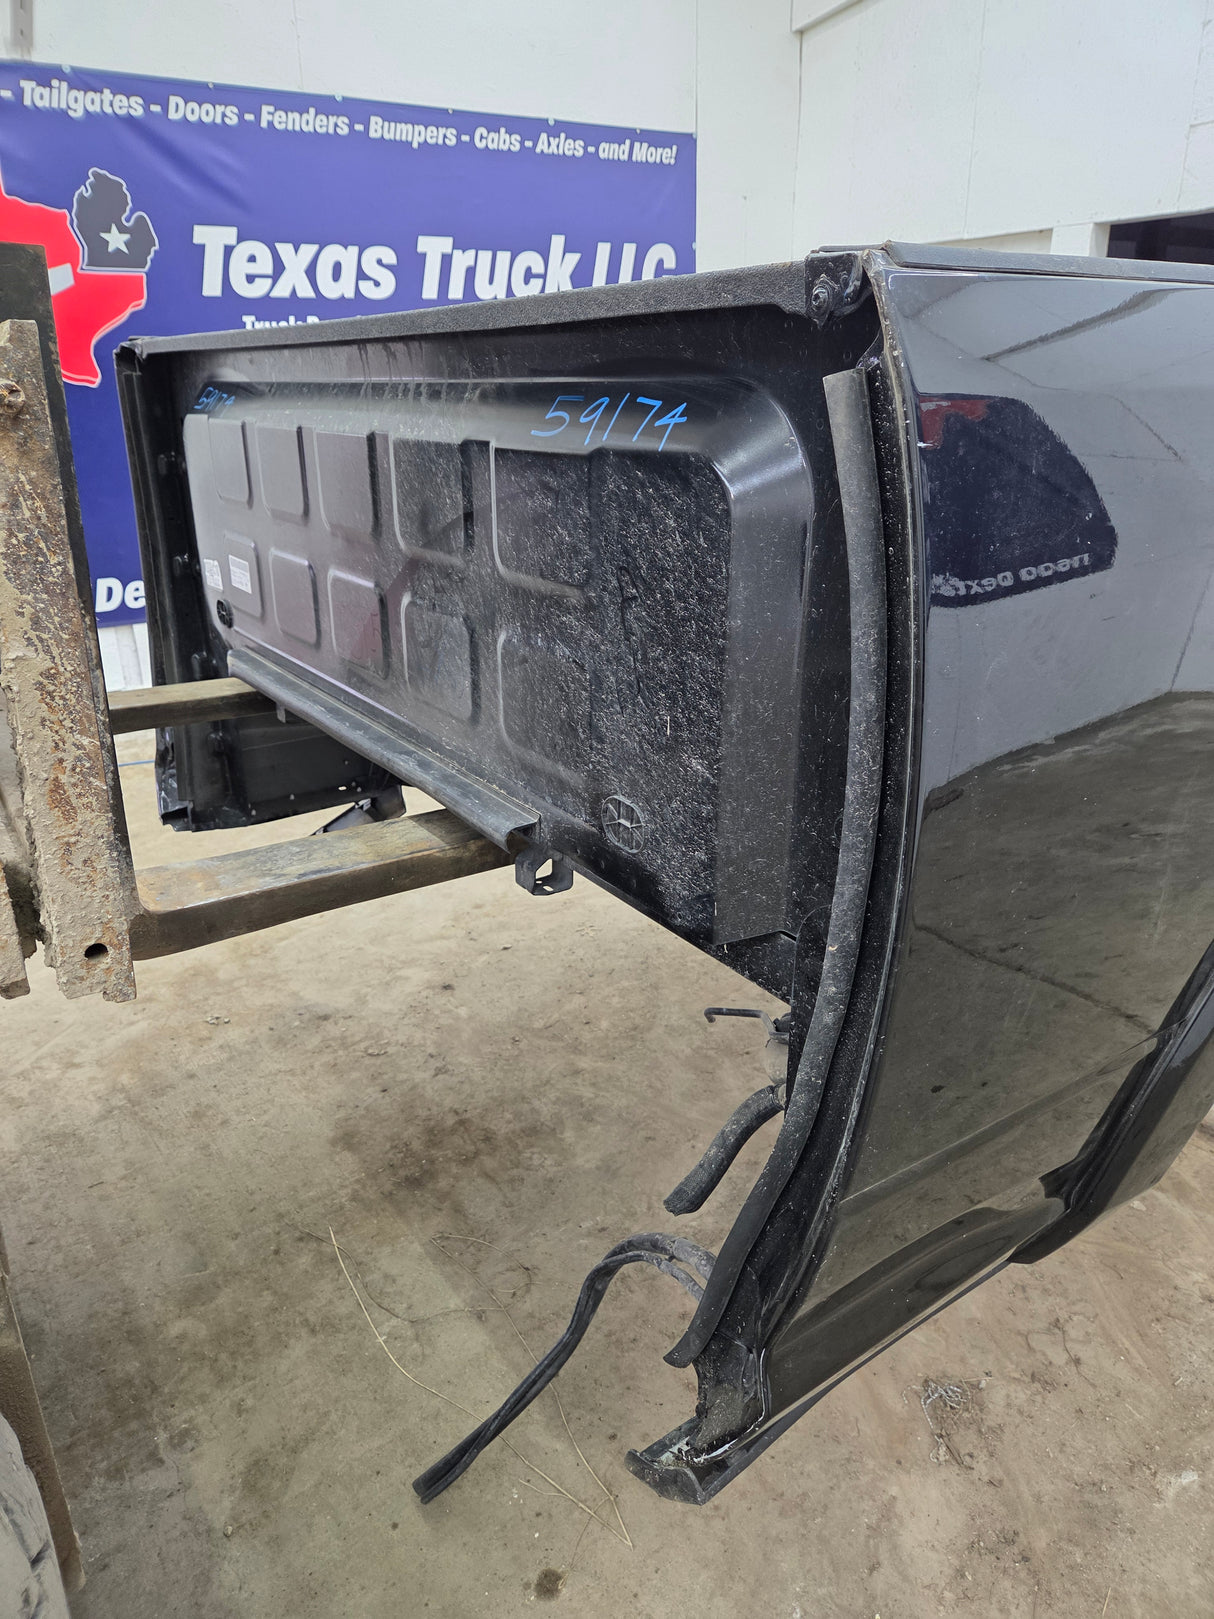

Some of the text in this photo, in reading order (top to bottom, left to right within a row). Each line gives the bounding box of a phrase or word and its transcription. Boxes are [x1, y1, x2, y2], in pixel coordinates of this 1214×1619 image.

[19, 79, 145, 117] Tailgates
[167, 95, 239, 125] Doors
[260, 104, 350, 135] Fenders
[368, 115, 457, 149] Bumpers
[474, 126, 521, 152] Cabs
[535, 132, 584, 157] Axles
[598, 139, 631, 161] and
[632, 142, 677, 165] More!
[192, 225, 398, 300] Texas
[416, 235, 581, 300] Truck
[531, 392, 688, 451] 59174
